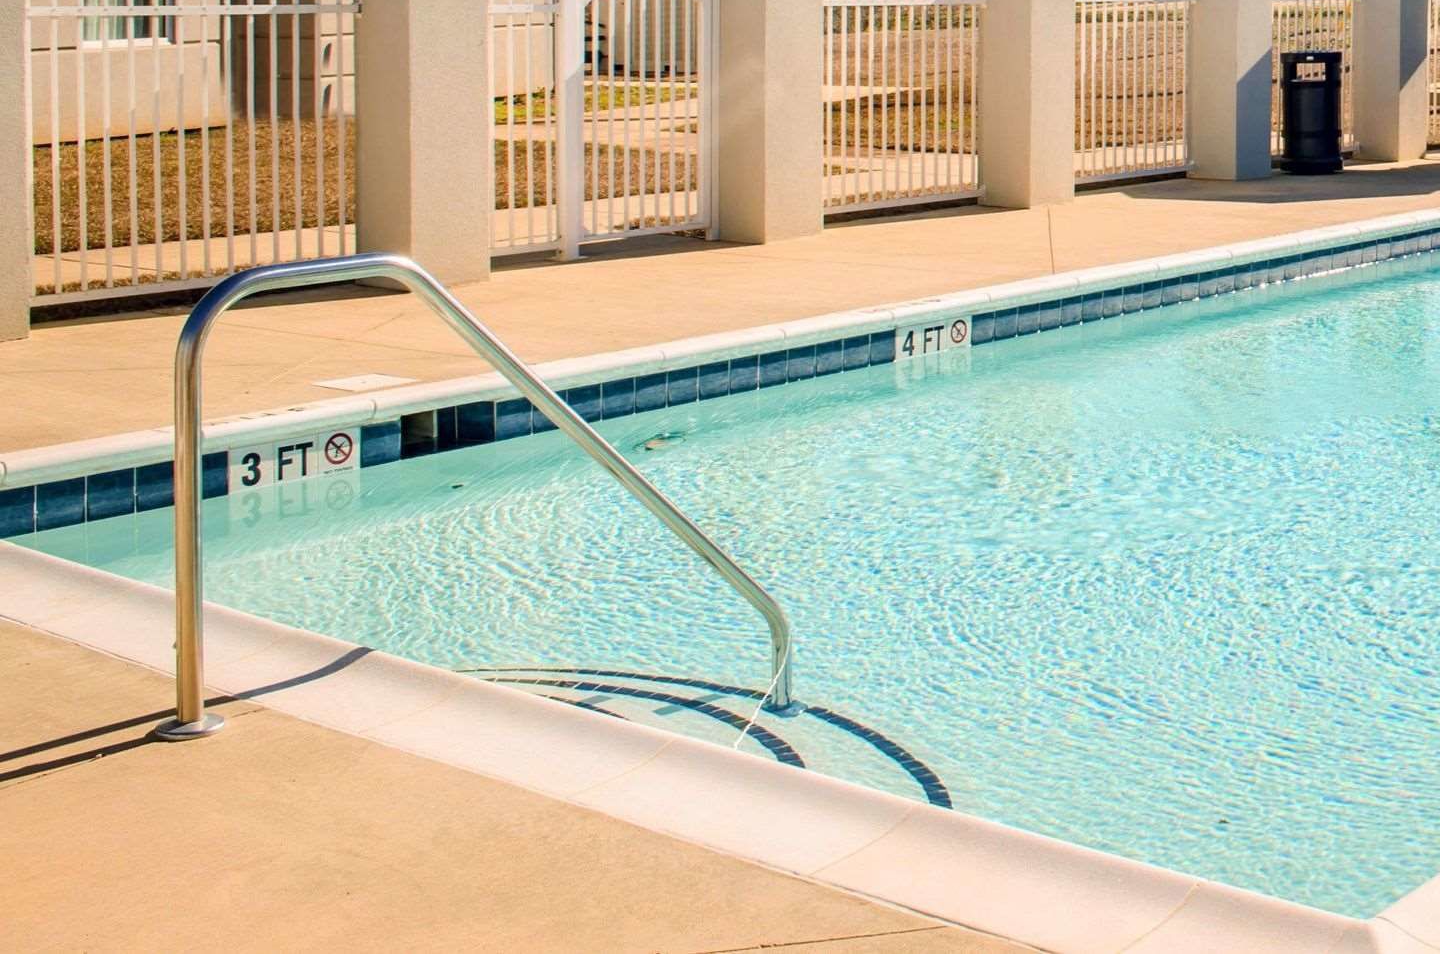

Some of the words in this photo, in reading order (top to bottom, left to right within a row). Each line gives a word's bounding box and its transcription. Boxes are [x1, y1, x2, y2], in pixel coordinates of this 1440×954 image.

[902, 330, 914, 356] 4
[924, 325, 944, 354] FT
[241, 452, 261, 486] 3
[278, 441, 313, 480] FT
